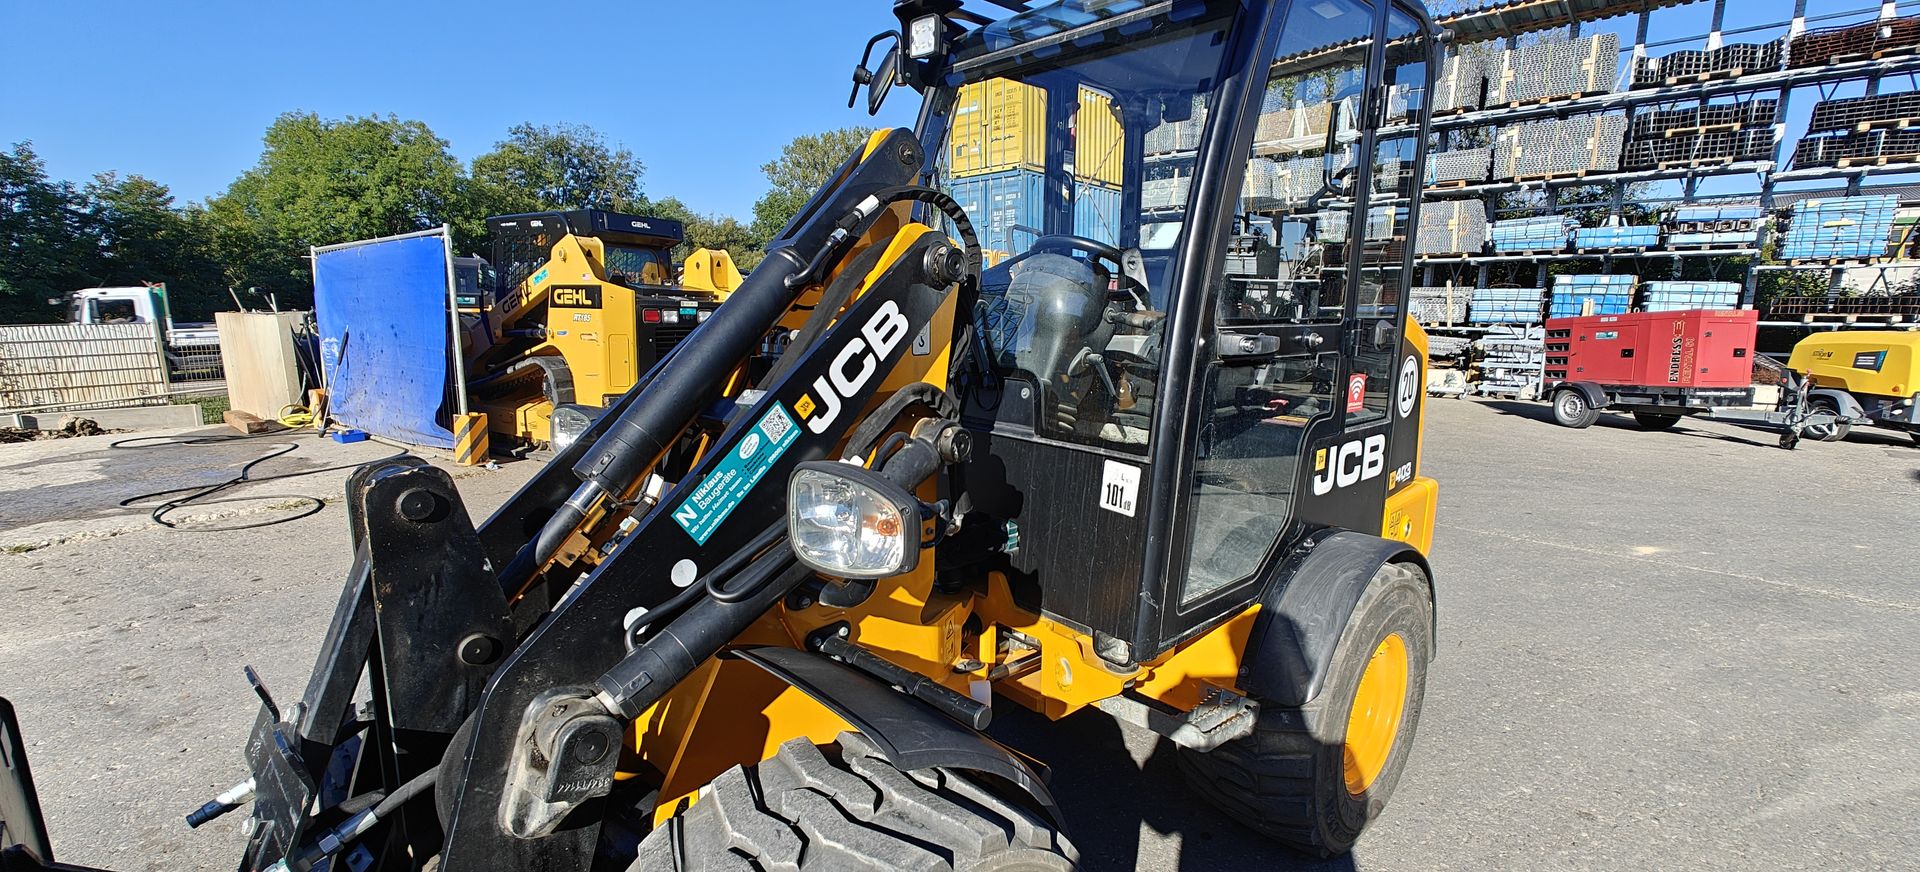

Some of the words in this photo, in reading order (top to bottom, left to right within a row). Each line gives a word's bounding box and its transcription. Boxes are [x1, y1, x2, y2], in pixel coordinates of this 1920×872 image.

[631, 221, 651, 229] GEHL
[553, 288, 593, 306] GEHL
[807, 300, 909, 434] JCB
[1669, 337, 1683, 383] ENDRESS
[1402, 370, 1415, 403] 20
[1313, 434, 1386, 497] JCB
[1395, 462, 1412, 482] 403
[691, 469, 723, 504] Niklaus
[697, 466, 738, 511] Baugeräte
[1106, 482, 1124, 509] 101
